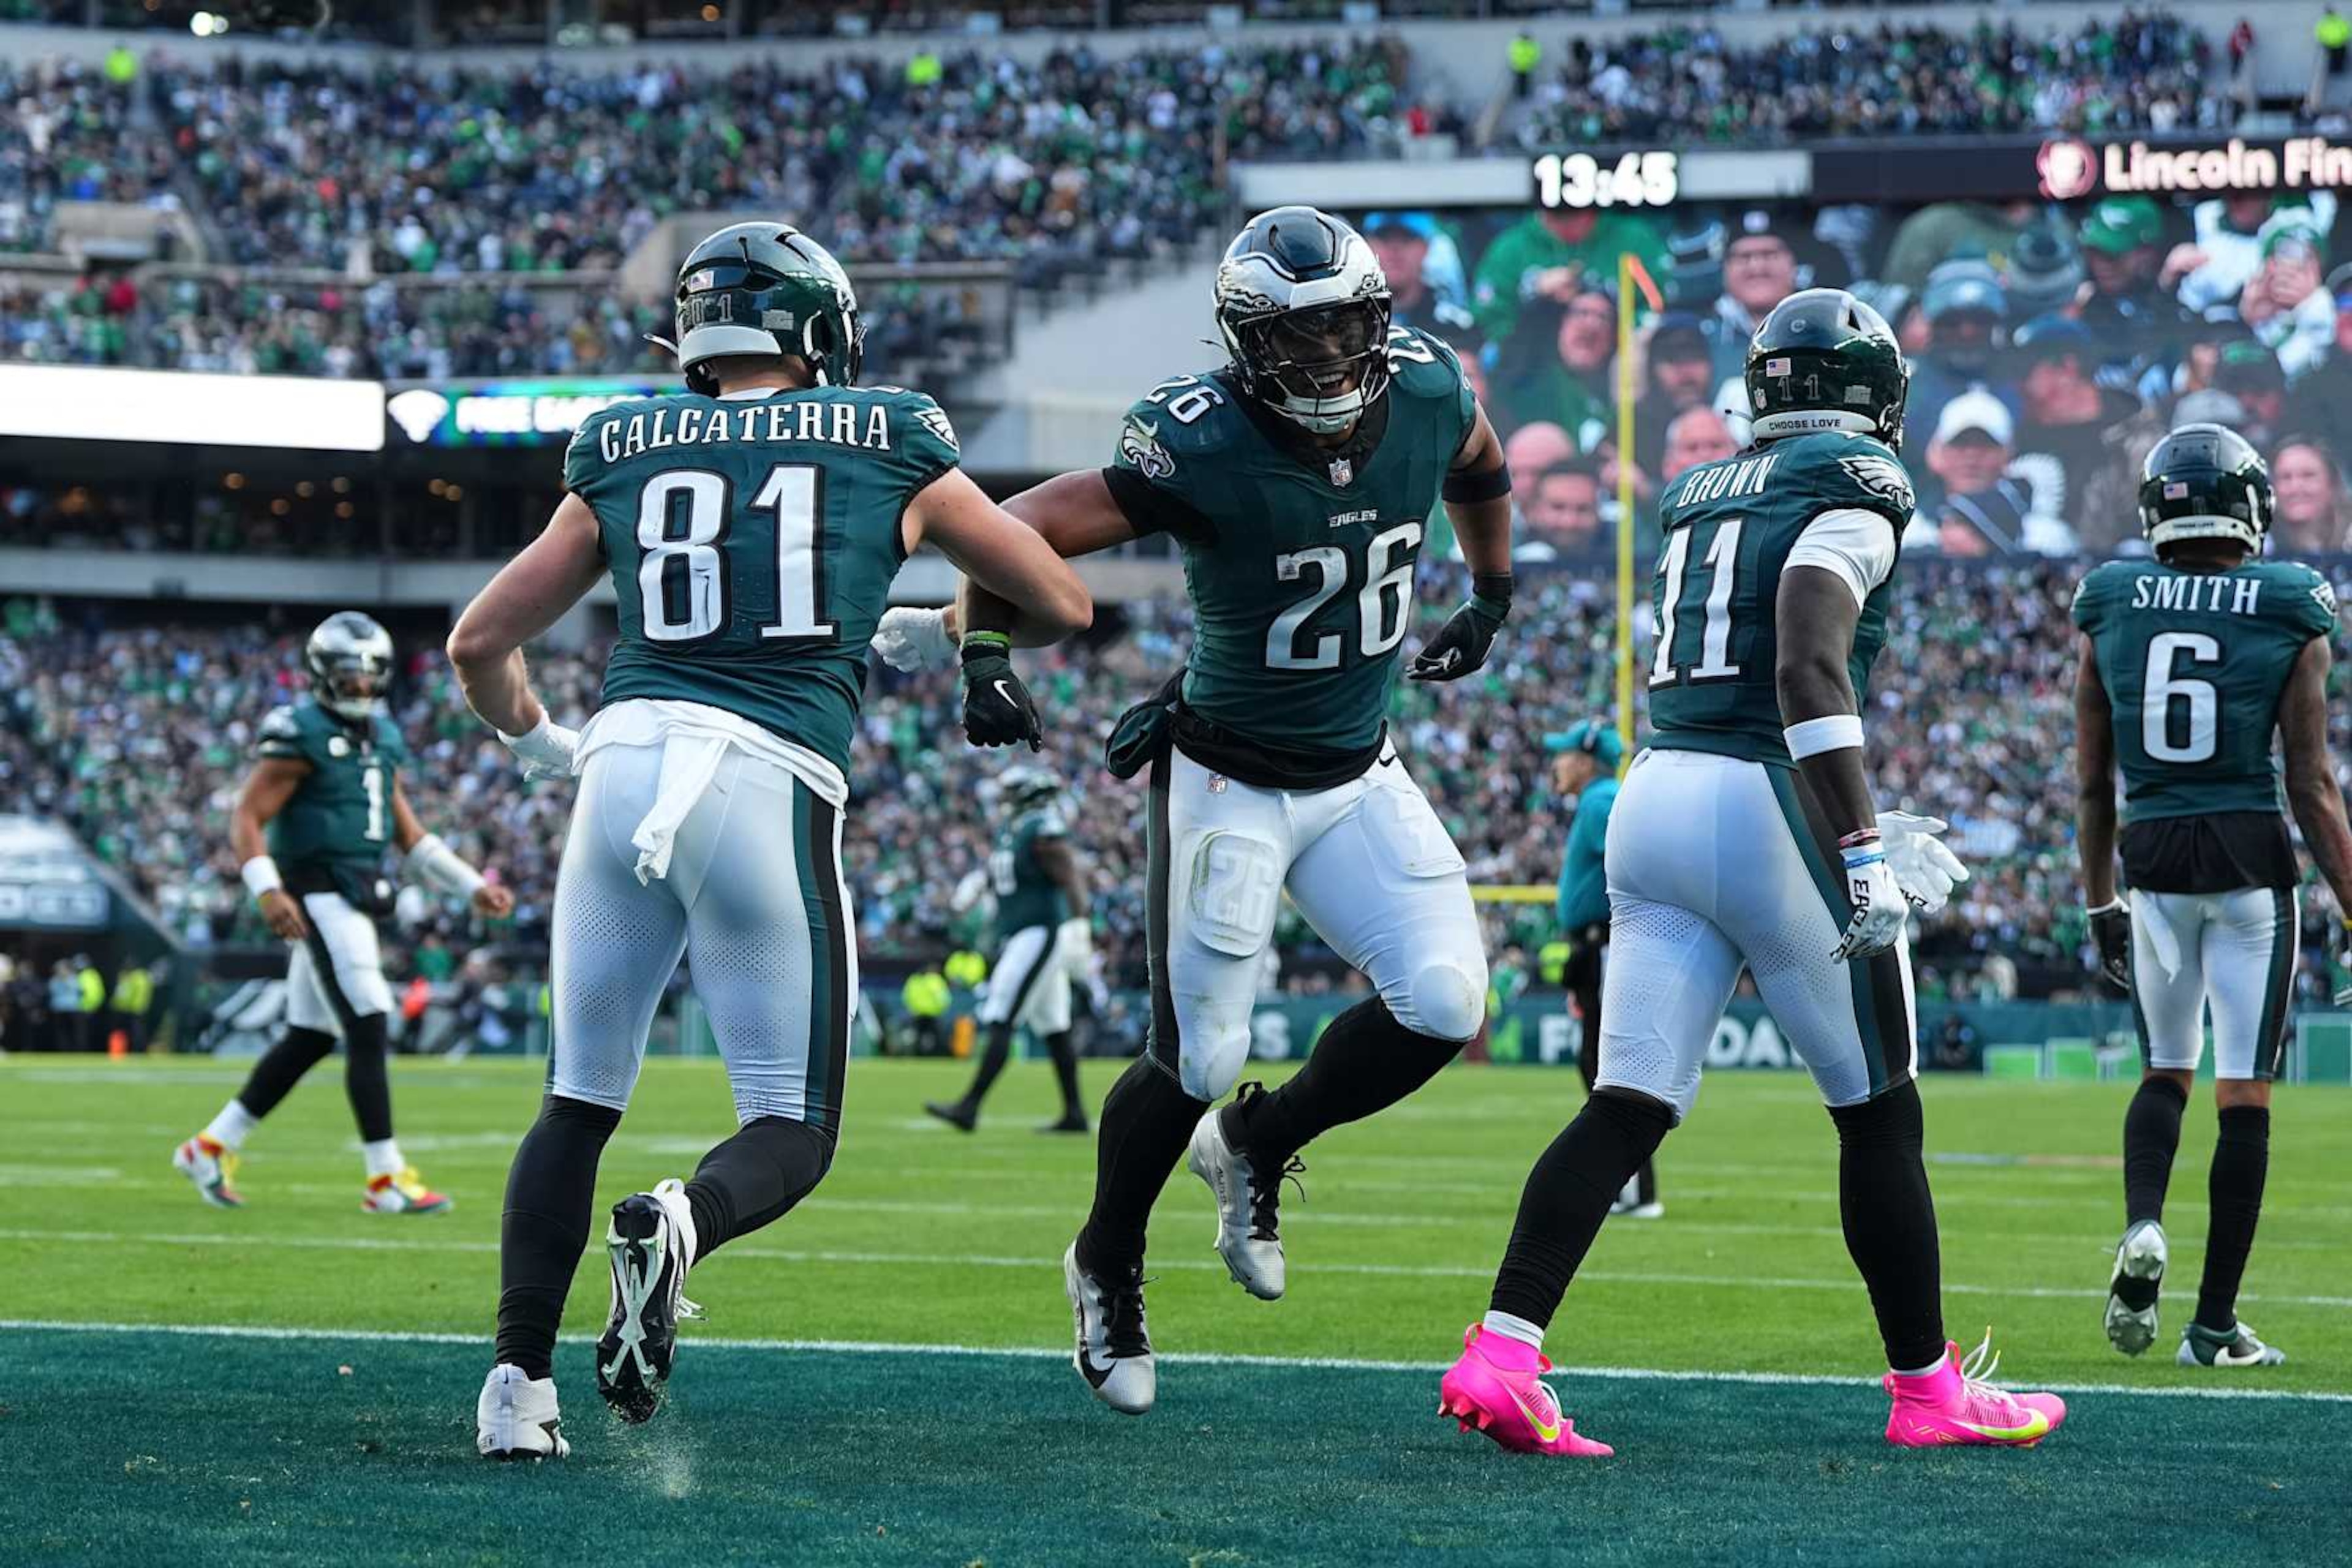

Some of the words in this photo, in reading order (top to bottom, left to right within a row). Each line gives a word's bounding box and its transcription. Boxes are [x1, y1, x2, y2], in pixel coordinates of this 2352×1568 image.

[1534, 151, 1678, 208] 13:45
[2105, 138, 2277, 191] Lincoln
[1145, 374, 1224, 423] 26
[1777, 374, 1821, 402] 11
[600, 401, 891, 463] CALCATERRA
[1769, 420, 1807, 431] CHOOSE
[1811, 418, 1841, 428] LOVE
[1676, 454, 1779, 508] BROWN
[1328, 509, 1378, 527] EAGLES
[636, 464, 837, 641] 81
[1265, 522, 1422, 669] 26
[1648, 519, 1743, 686] 11
[2132, 575, 2262, 614] SMITH
[2143, 632, 2219, 763] 6
[362, 767, 385, 842] 1
